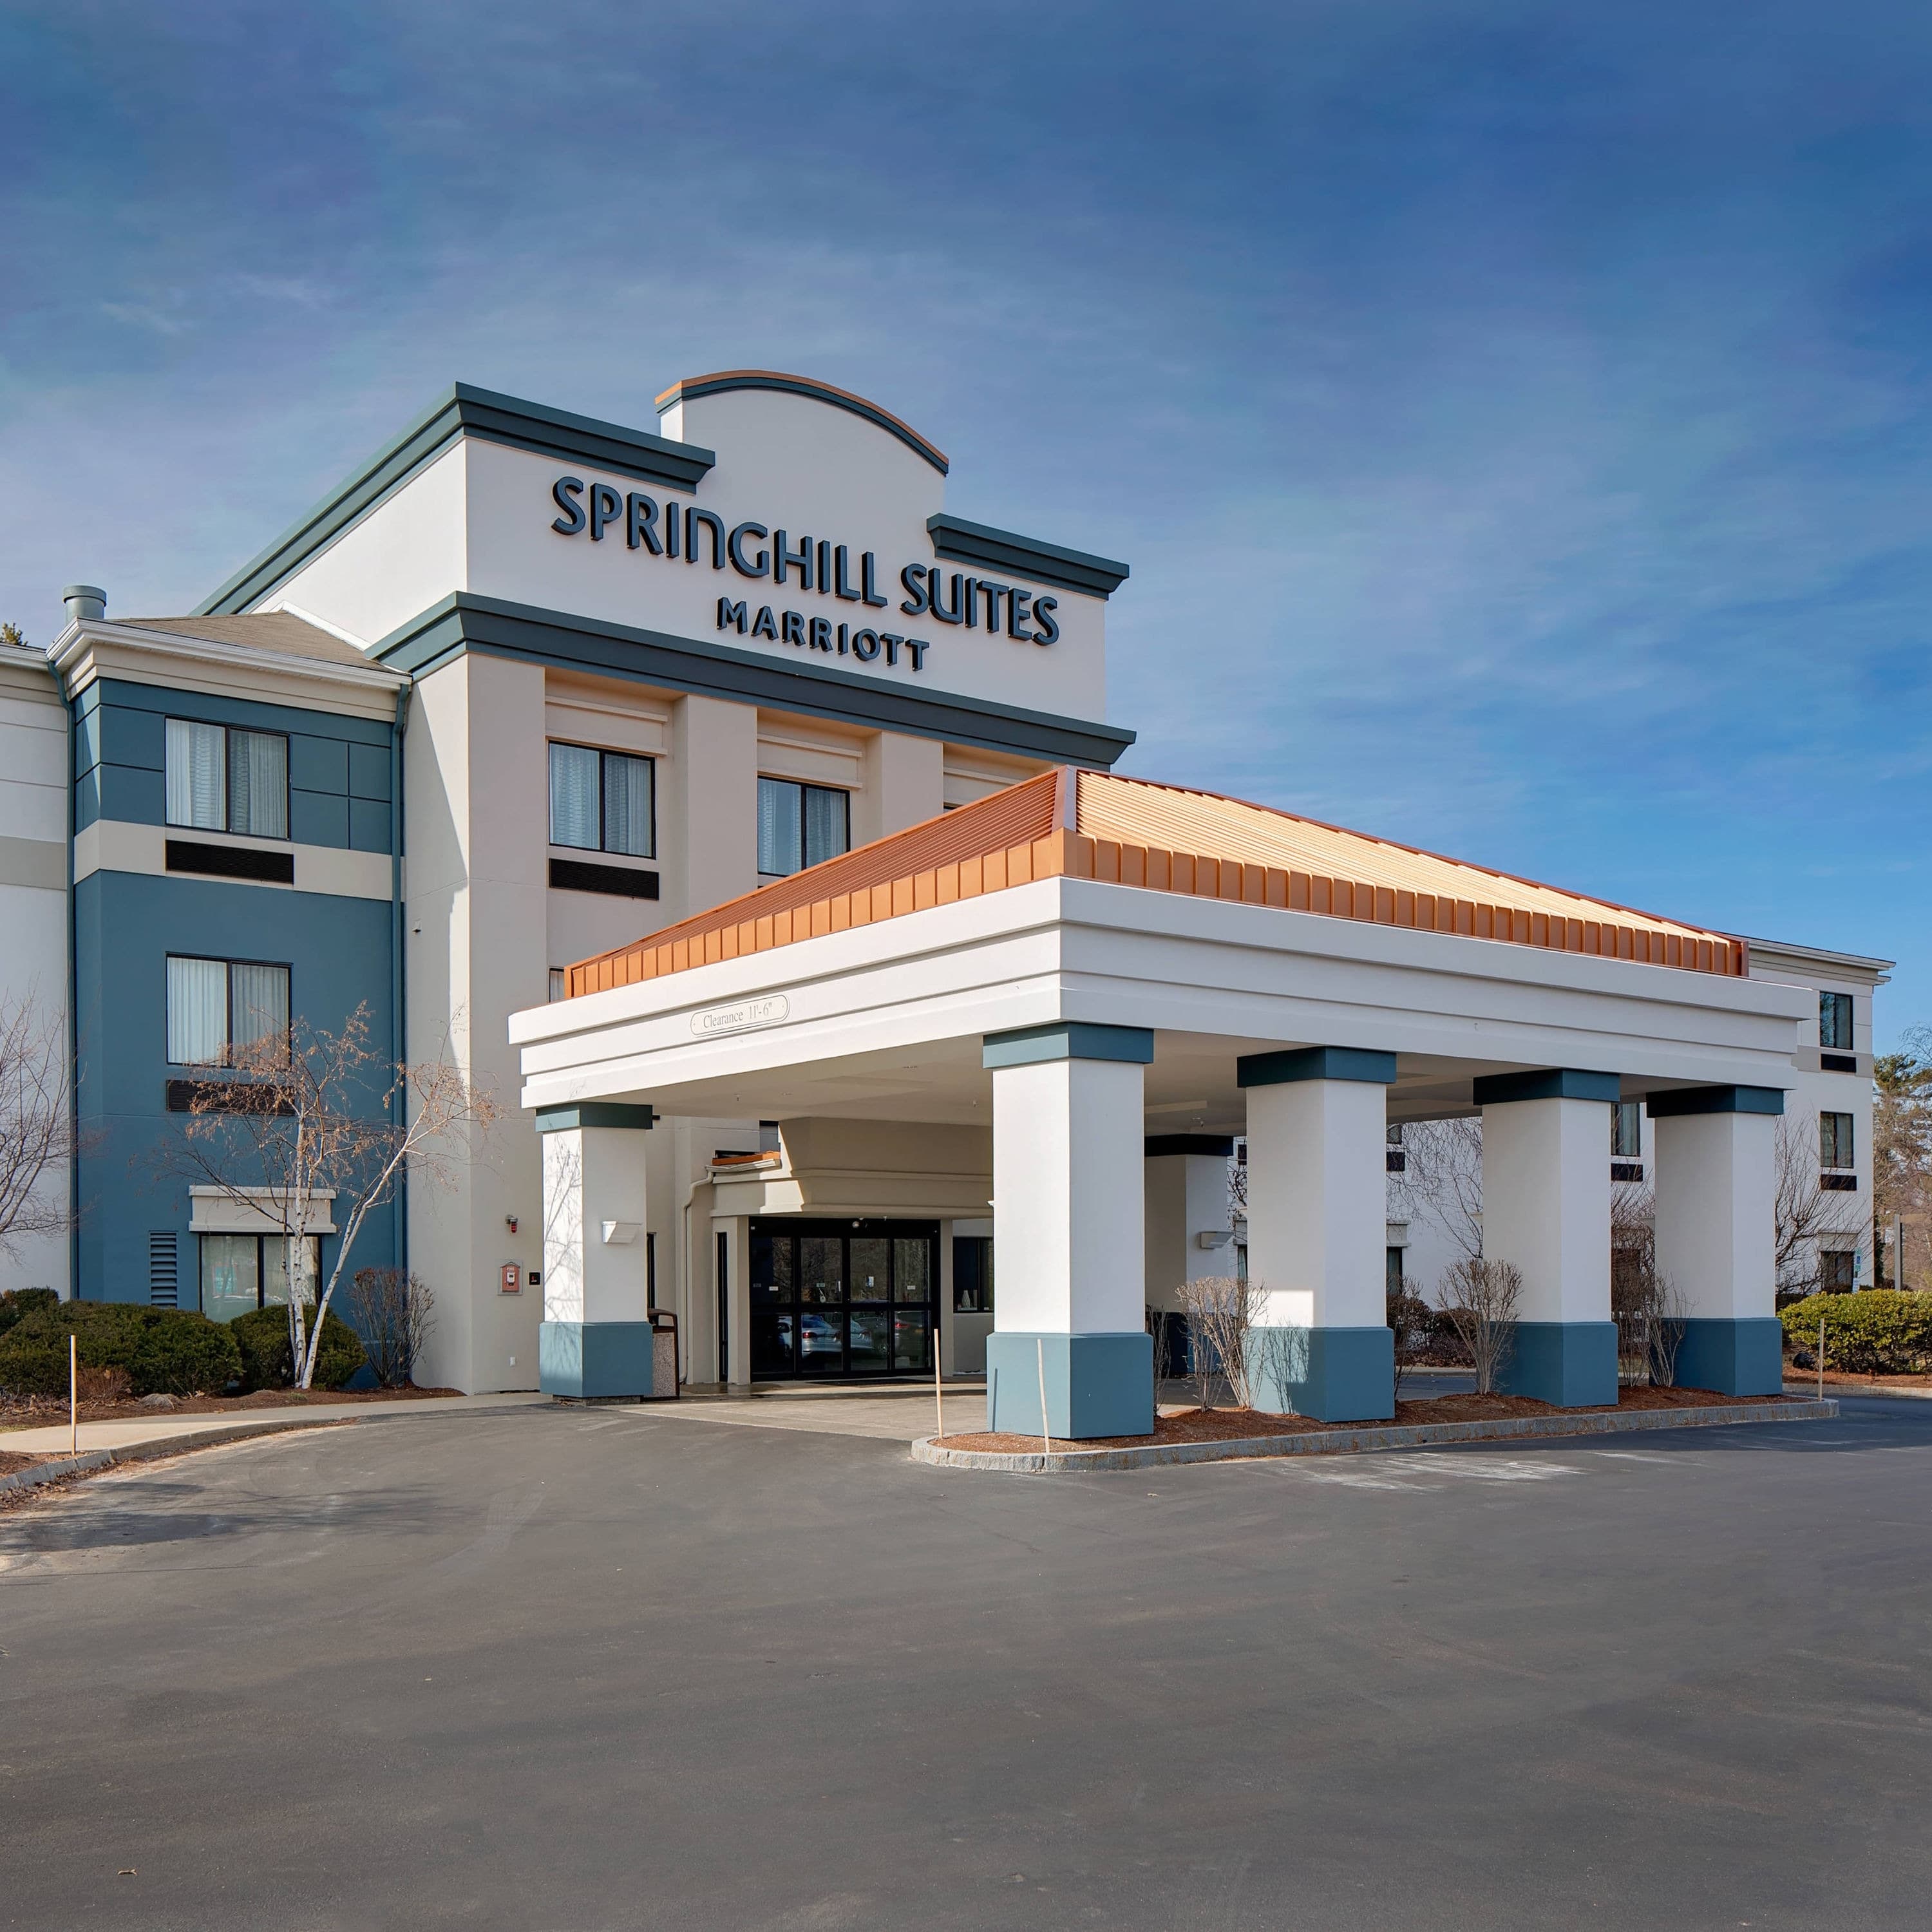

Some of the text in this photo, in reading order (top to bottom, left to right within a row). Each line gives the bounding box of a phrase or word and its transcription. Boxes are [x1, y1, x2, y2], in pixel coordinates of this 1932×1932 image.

[552, 477, 1059, 646] SPRINGHILL SUITES
[717, 597, 931, 672] MARRIOTT
[703, 1012, 744, 1028] Clearance
